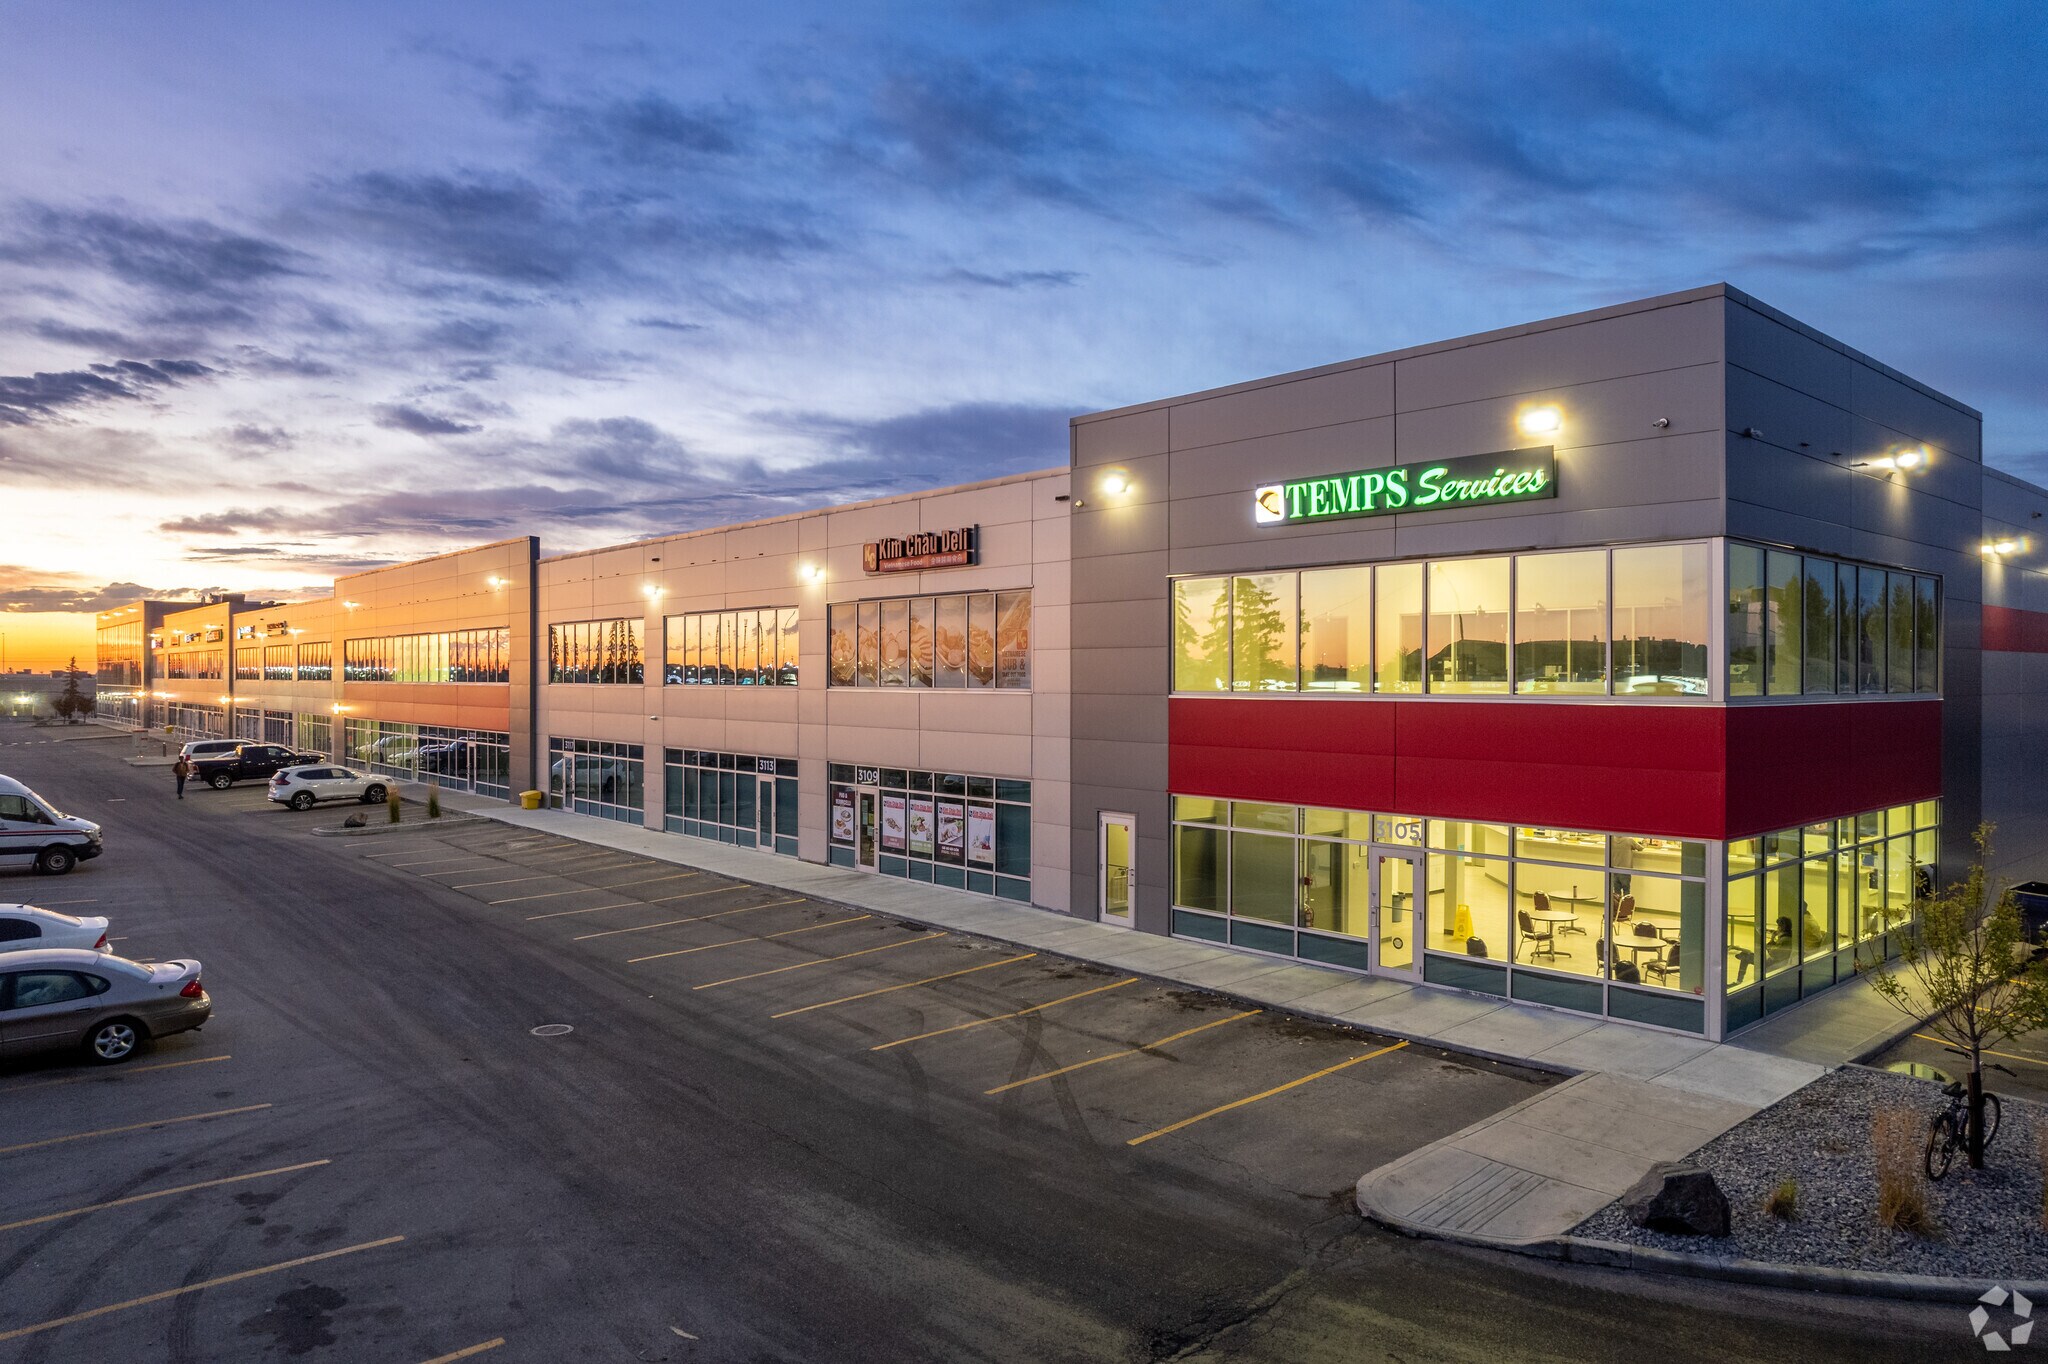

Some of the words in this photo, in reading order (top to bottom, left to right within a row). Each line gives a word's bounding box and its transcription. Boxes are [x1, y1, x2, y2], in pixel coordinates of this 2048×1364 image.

[1286, 469, 1408, 518] TEMPS
[1414, 467, 1550, 506] Services
[879, 538, 902, 559] Kim
[941, 528, 967, 552] Deli
[759, 760, 774, 771] 3113
[858, 769, 878, 782] 3109
[1376, 820, 1420, 841] 3105
